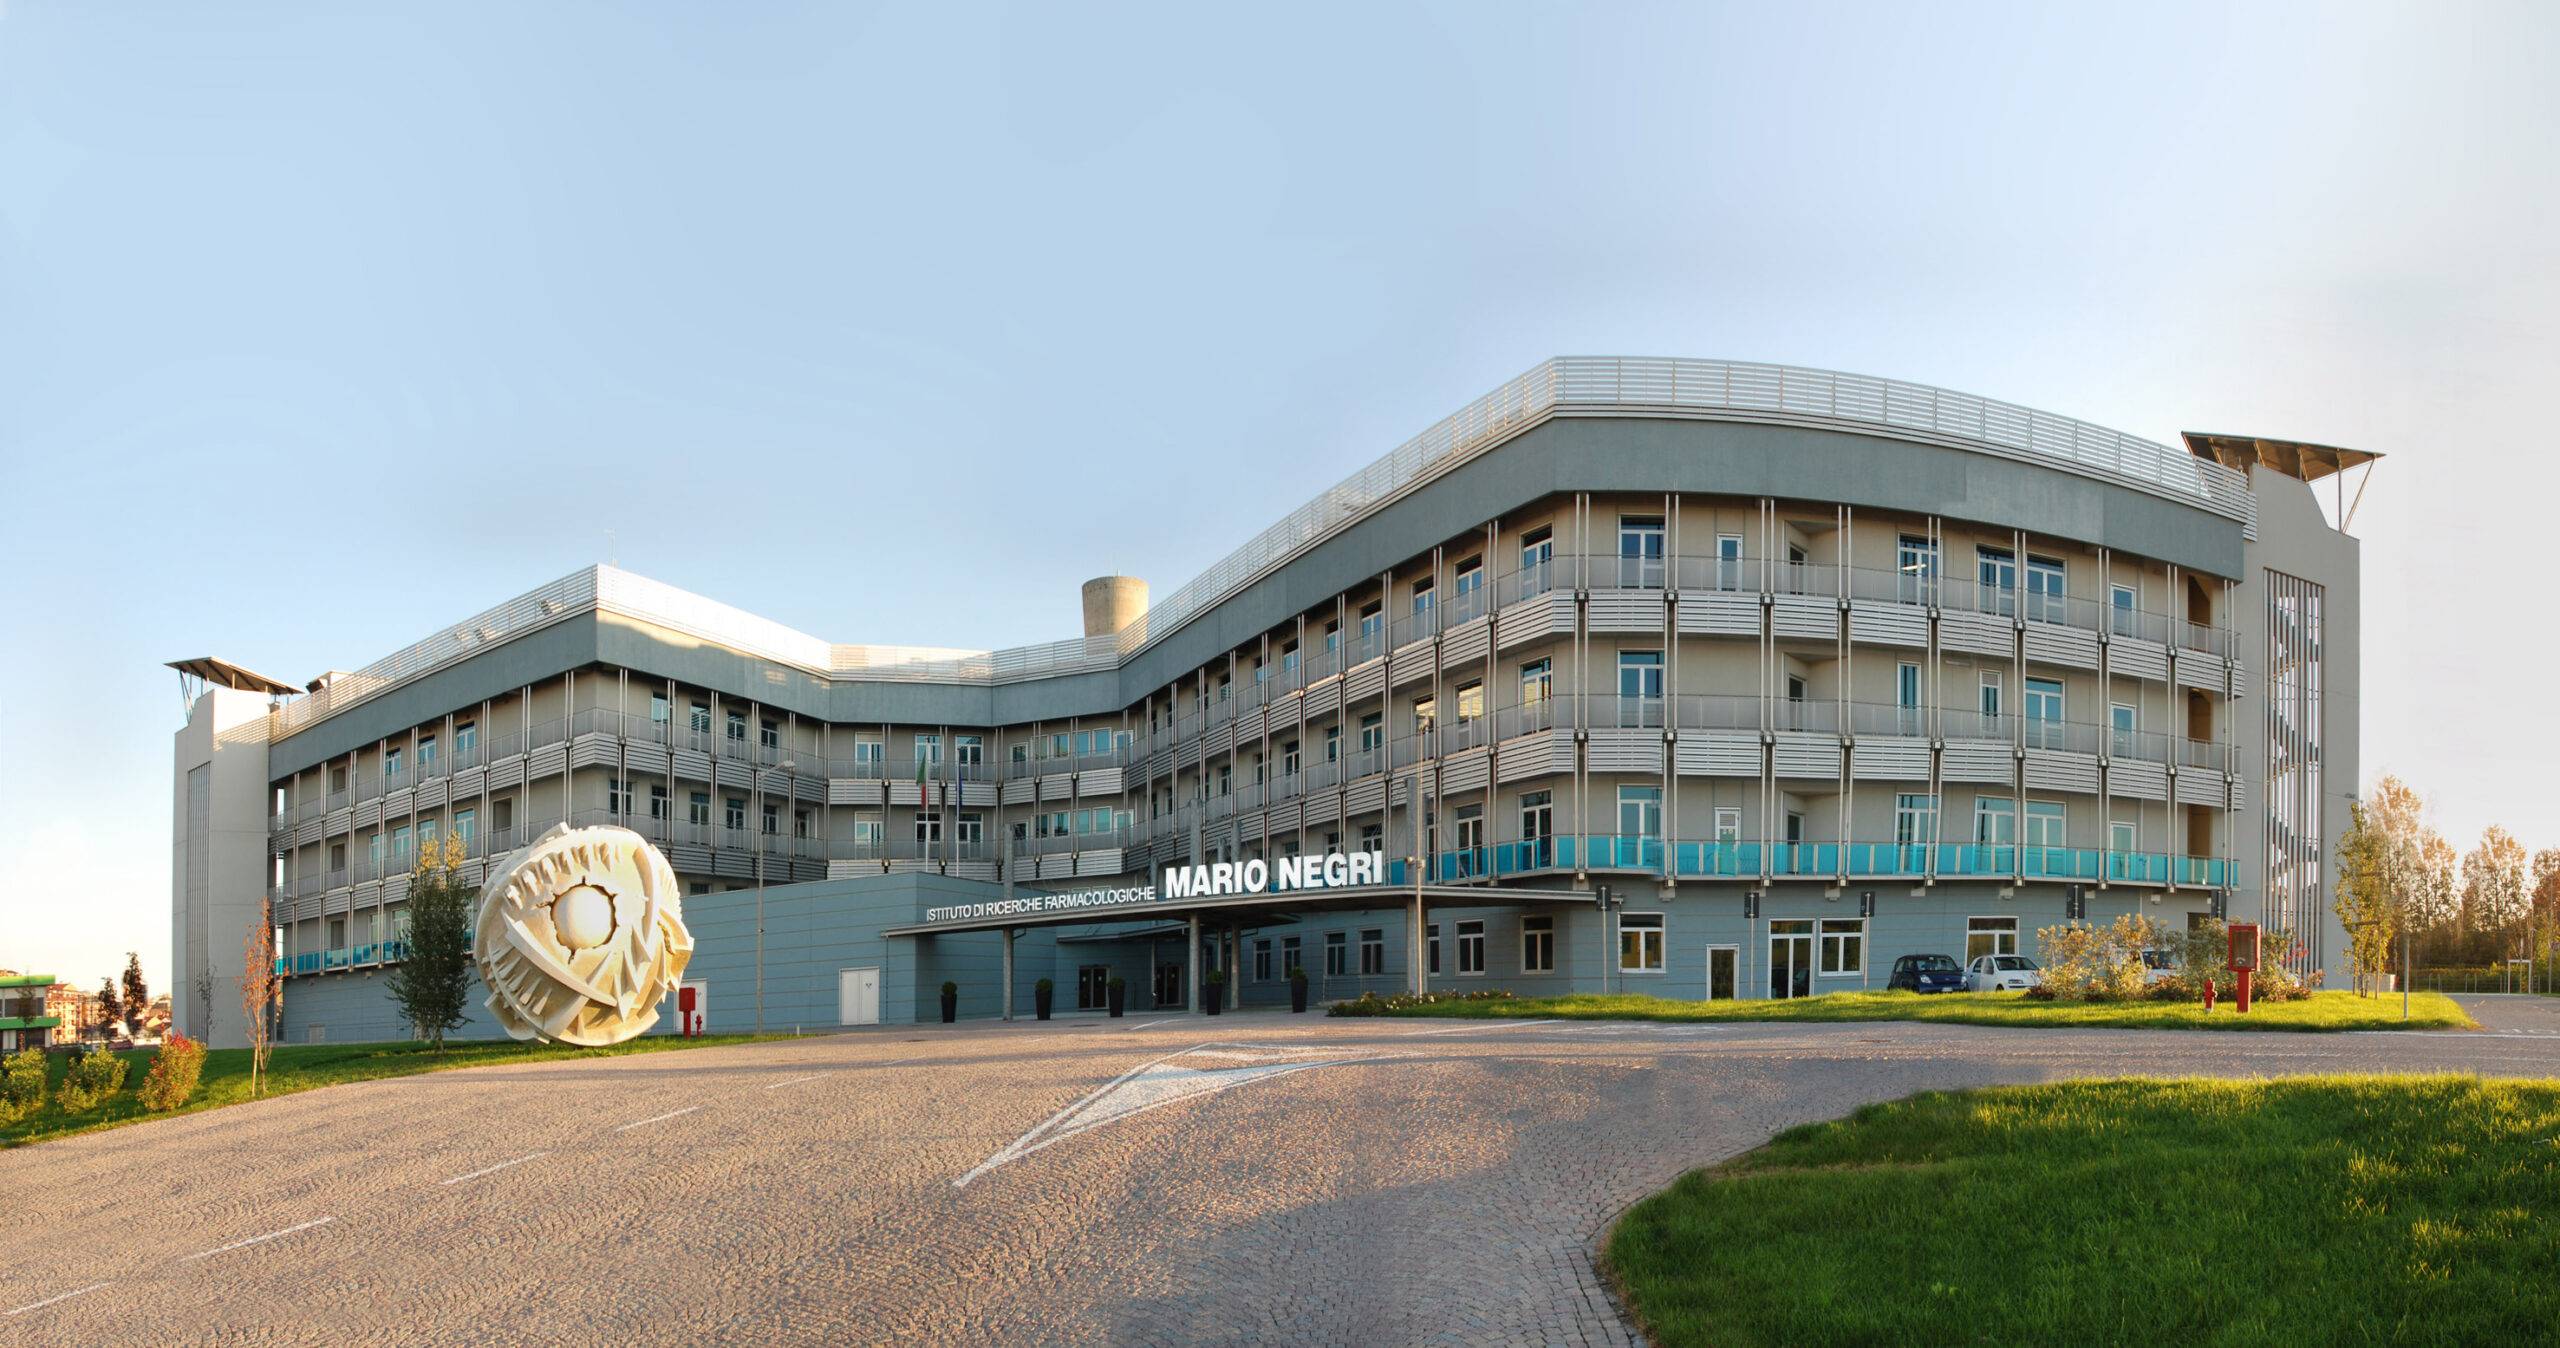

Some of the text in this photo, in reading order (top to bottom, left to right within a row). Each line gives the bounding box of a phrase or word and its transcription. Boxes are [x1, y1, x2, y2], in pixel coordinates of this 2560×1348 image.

[926, 850, 1383, 922] ISTITUTO DI RICERCHE FARMACOLOGICHE MARIO NEGRI
